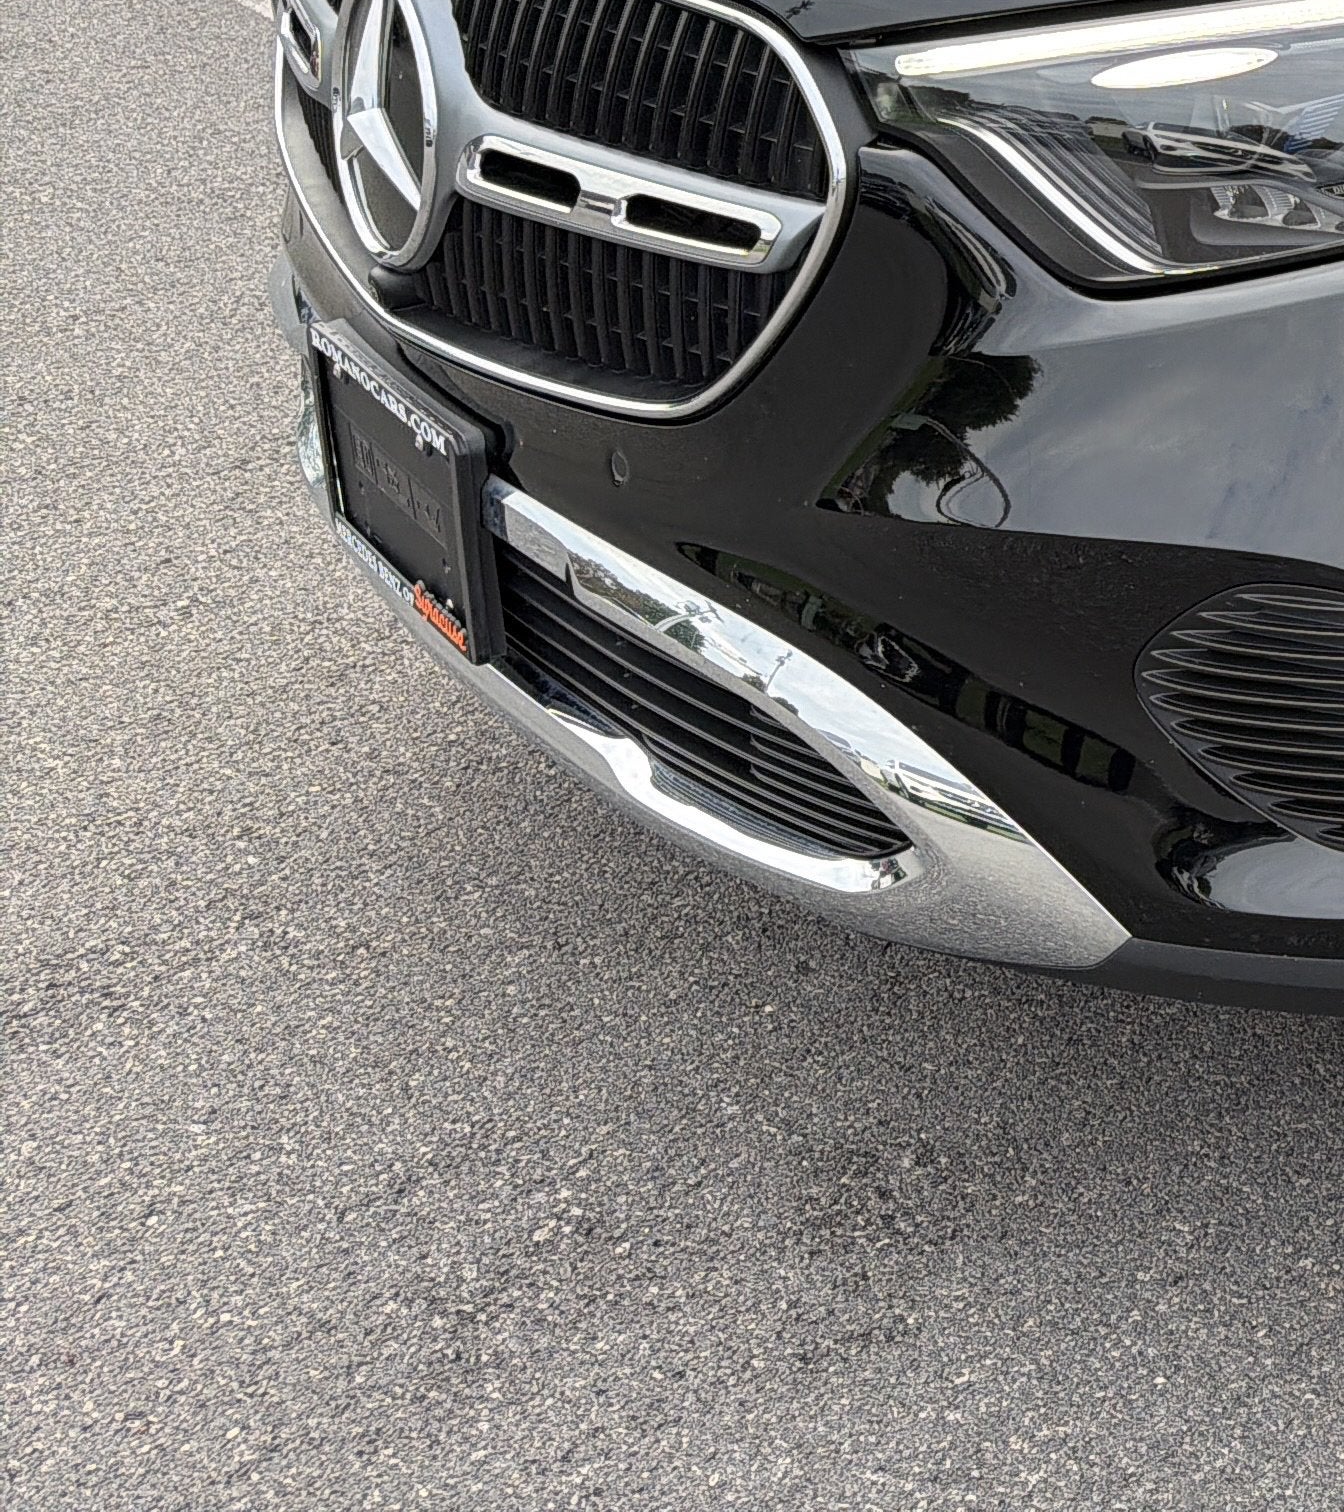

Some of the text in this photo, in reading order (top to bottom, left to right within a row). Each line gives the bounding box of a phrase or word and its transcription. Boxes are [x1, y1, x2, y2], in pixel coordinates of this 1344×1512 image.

[310, 328, 447, 456] ROMANOCARS.COM
[335, 516, 377, 574] MERCEDES
[376, 560, 402, 597] BENZ
[412, 579, 467, 653] Syracuse
